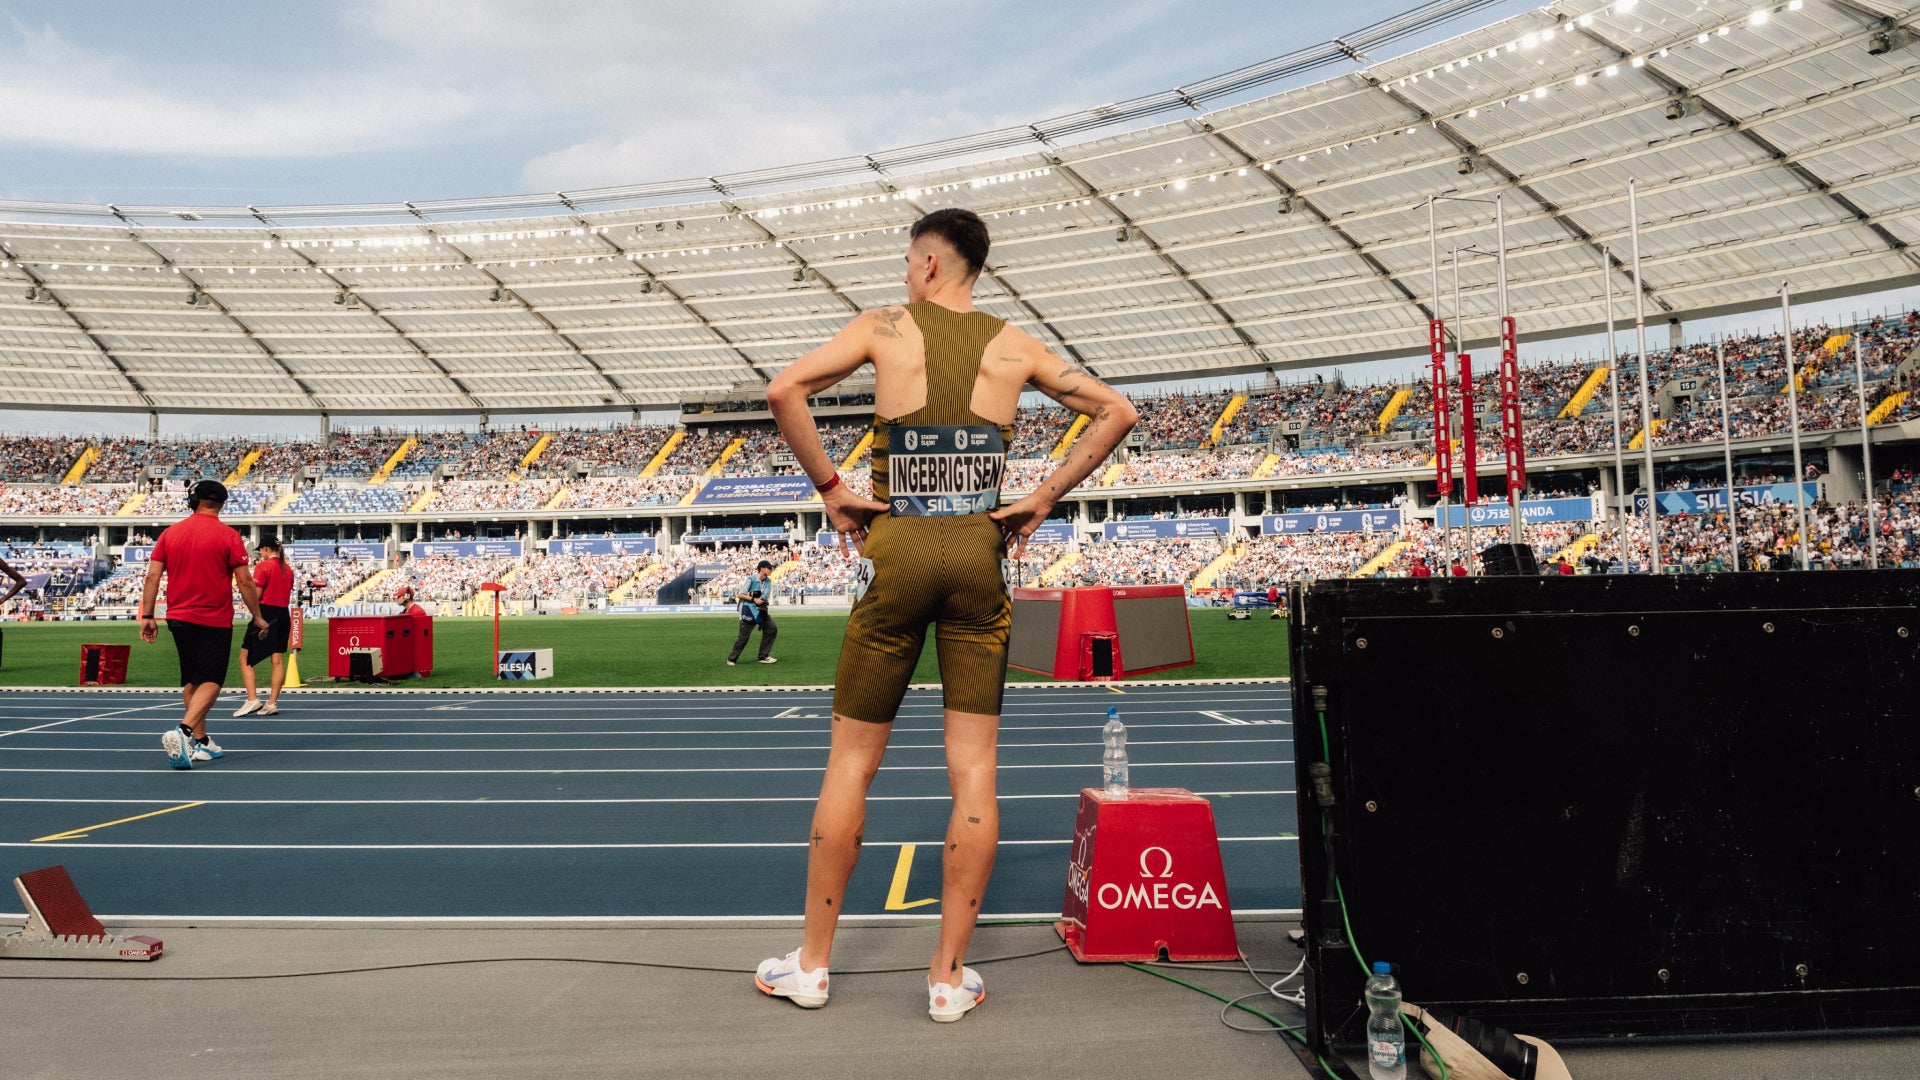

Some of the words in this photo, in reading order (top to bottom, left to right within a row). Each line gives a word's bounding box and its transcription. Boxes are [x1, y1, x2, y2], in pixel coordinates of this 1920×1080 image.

[892, 455, 1002, 493] INGEBRIGTSEN
[732, 482, 807, 490] ZOBACZENIA
[927, 496, 985, 513] SILESIA
[1520, 506, 1554, 517] ANDA
[292, 618, 300, 645] OMEGA
[499, 662, 532, 672] SILESIA
[1068, 863, 1089, 903] OMEGA
[1097, 882, 1223, 909] OMEGA
